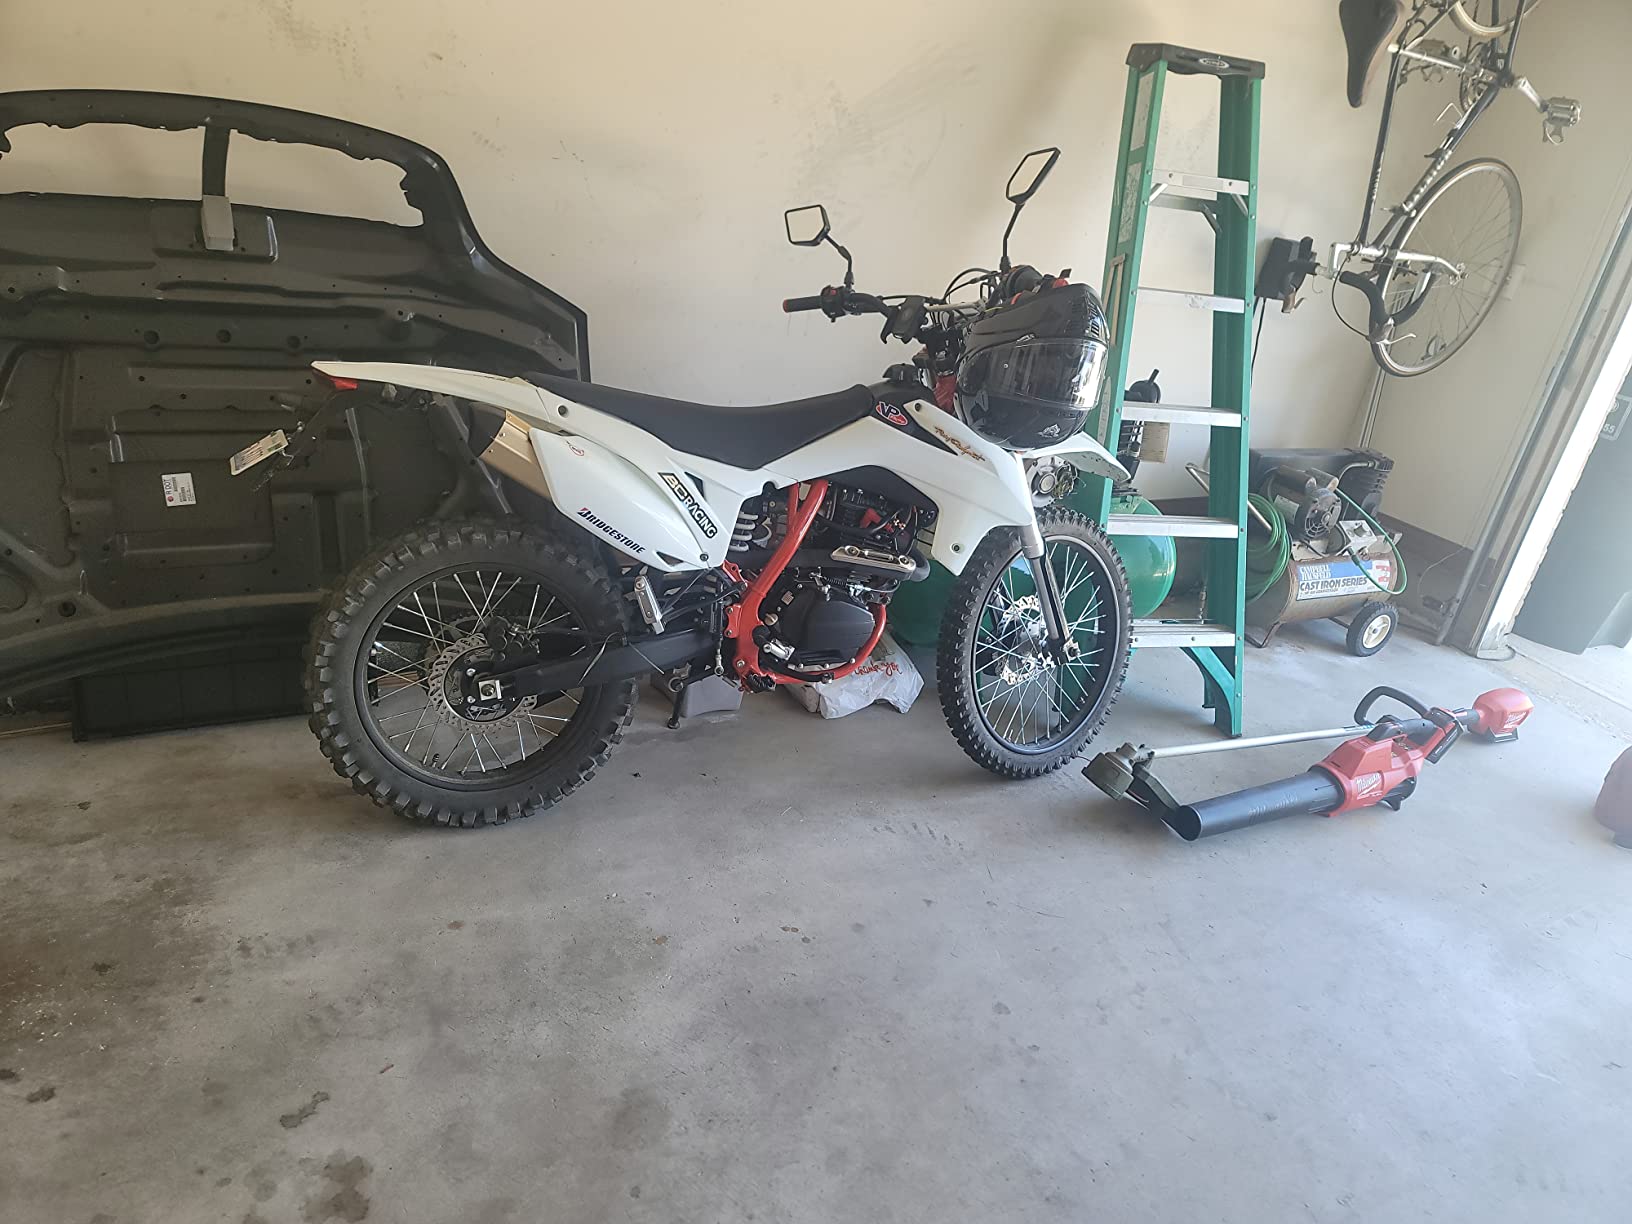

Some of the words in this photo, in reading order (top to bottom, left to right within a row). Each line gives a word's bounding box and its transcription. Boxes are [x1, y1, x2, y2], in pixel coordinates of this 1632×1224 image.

[577, 507, 646, 554] BRIDGESTONE
[1300, 580, 1320, 591] CAST
[1320, 579, 1340, 589] IRON
[1341, 577, 1368, 587] SERIES
